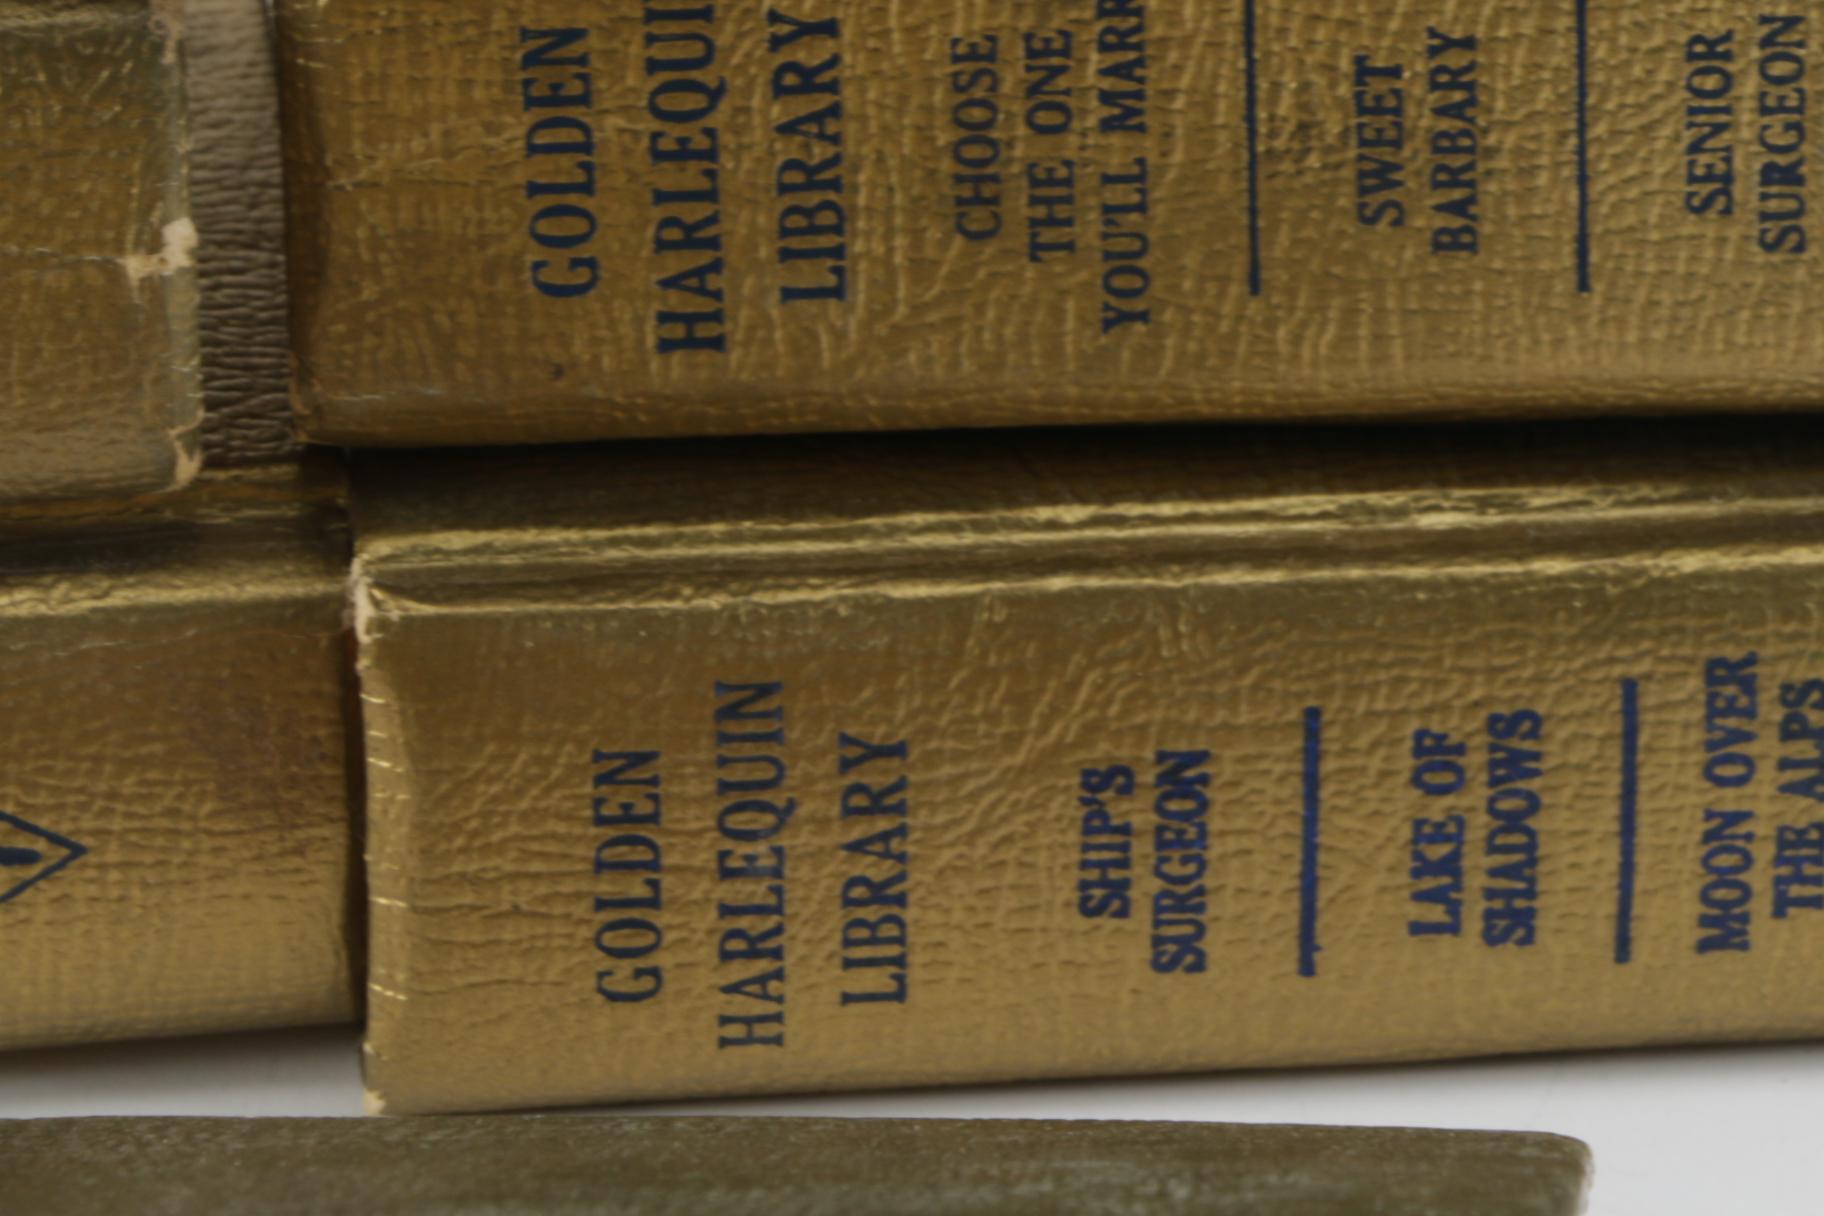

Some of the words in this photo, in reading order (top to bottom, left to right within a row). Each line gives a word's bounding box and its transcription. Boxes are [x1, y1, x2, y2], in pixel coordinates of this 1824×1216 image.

[519, 27, 600, 299] GOLDEN
[766, 9, 849, 303] LIBRARY
[950, 34, 1003, 242] CHOOSE
[1023, 29, 1074, 136] ONE
[1353, 53, 1405, 228] SWEET
[1426, 26, 1479, 254] BARBARY
[1684, 30, 1736, 217] SENIOR
[1758, 14, 1807, 254] SURGEON
[1026, 158, 1076, 262] THE
[1099, 157, 1152, 333] YOU'LL
[1410, 727, 1468, 797] OF
[1702, 650, 1760, 789] OVER
[591, 750, 663, 1003] GOLDEN
[713, 680, 797, 1047] HARLEQUIN
[837, 732, 910, 1005] LIBRARY
[1077, 763, 1137, 919] SHIP'S
[1150, 749, 1212, 974] SURGEON
[1407, 814, 1467, 937] LAKE
[1481, 708, 1544, 948] SHADOWS
[1695, 807, 1756, 954] MOON
